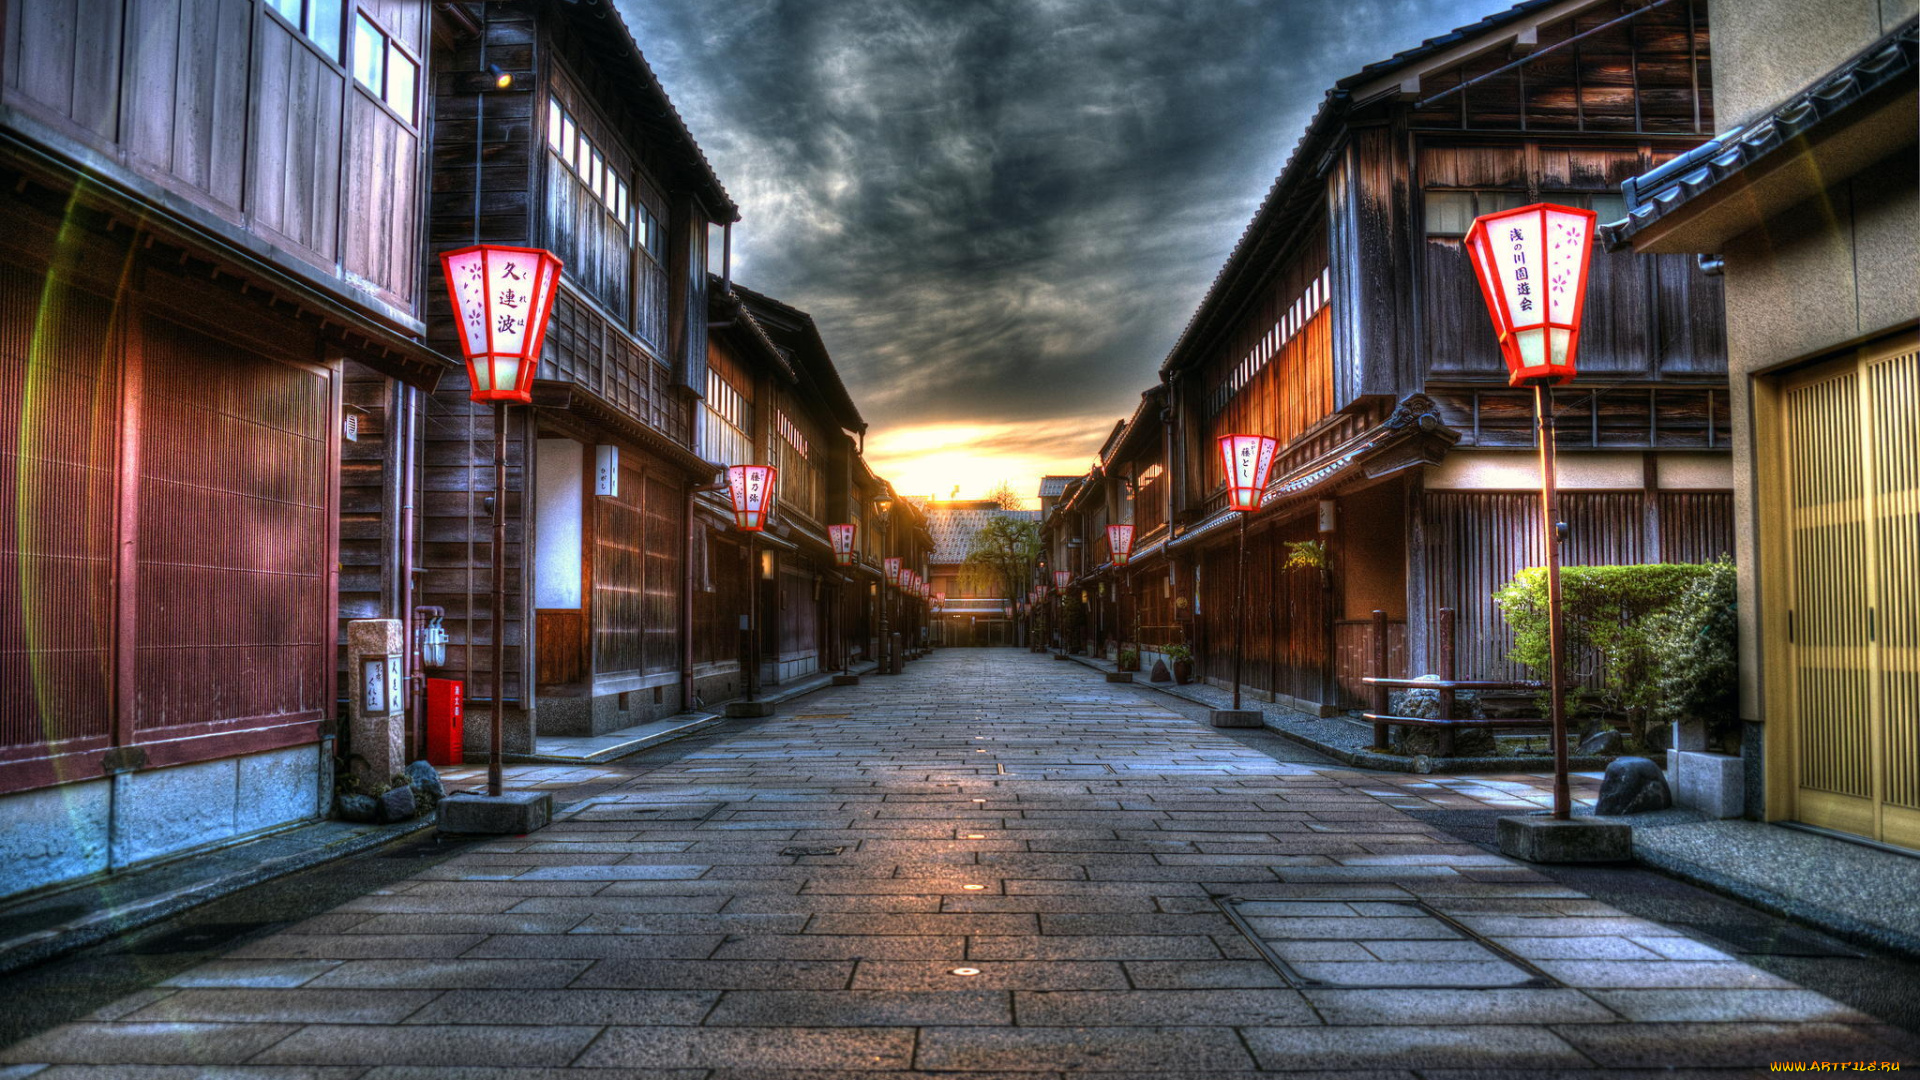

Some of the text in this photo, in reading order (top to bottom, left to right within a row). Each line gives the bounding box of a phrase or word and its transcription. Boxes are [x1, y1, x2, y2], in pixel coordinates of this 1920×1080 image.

[497, 261, 521, 335] 久連波
[1510, 227, 1533, 312] 浅の川園遊会
